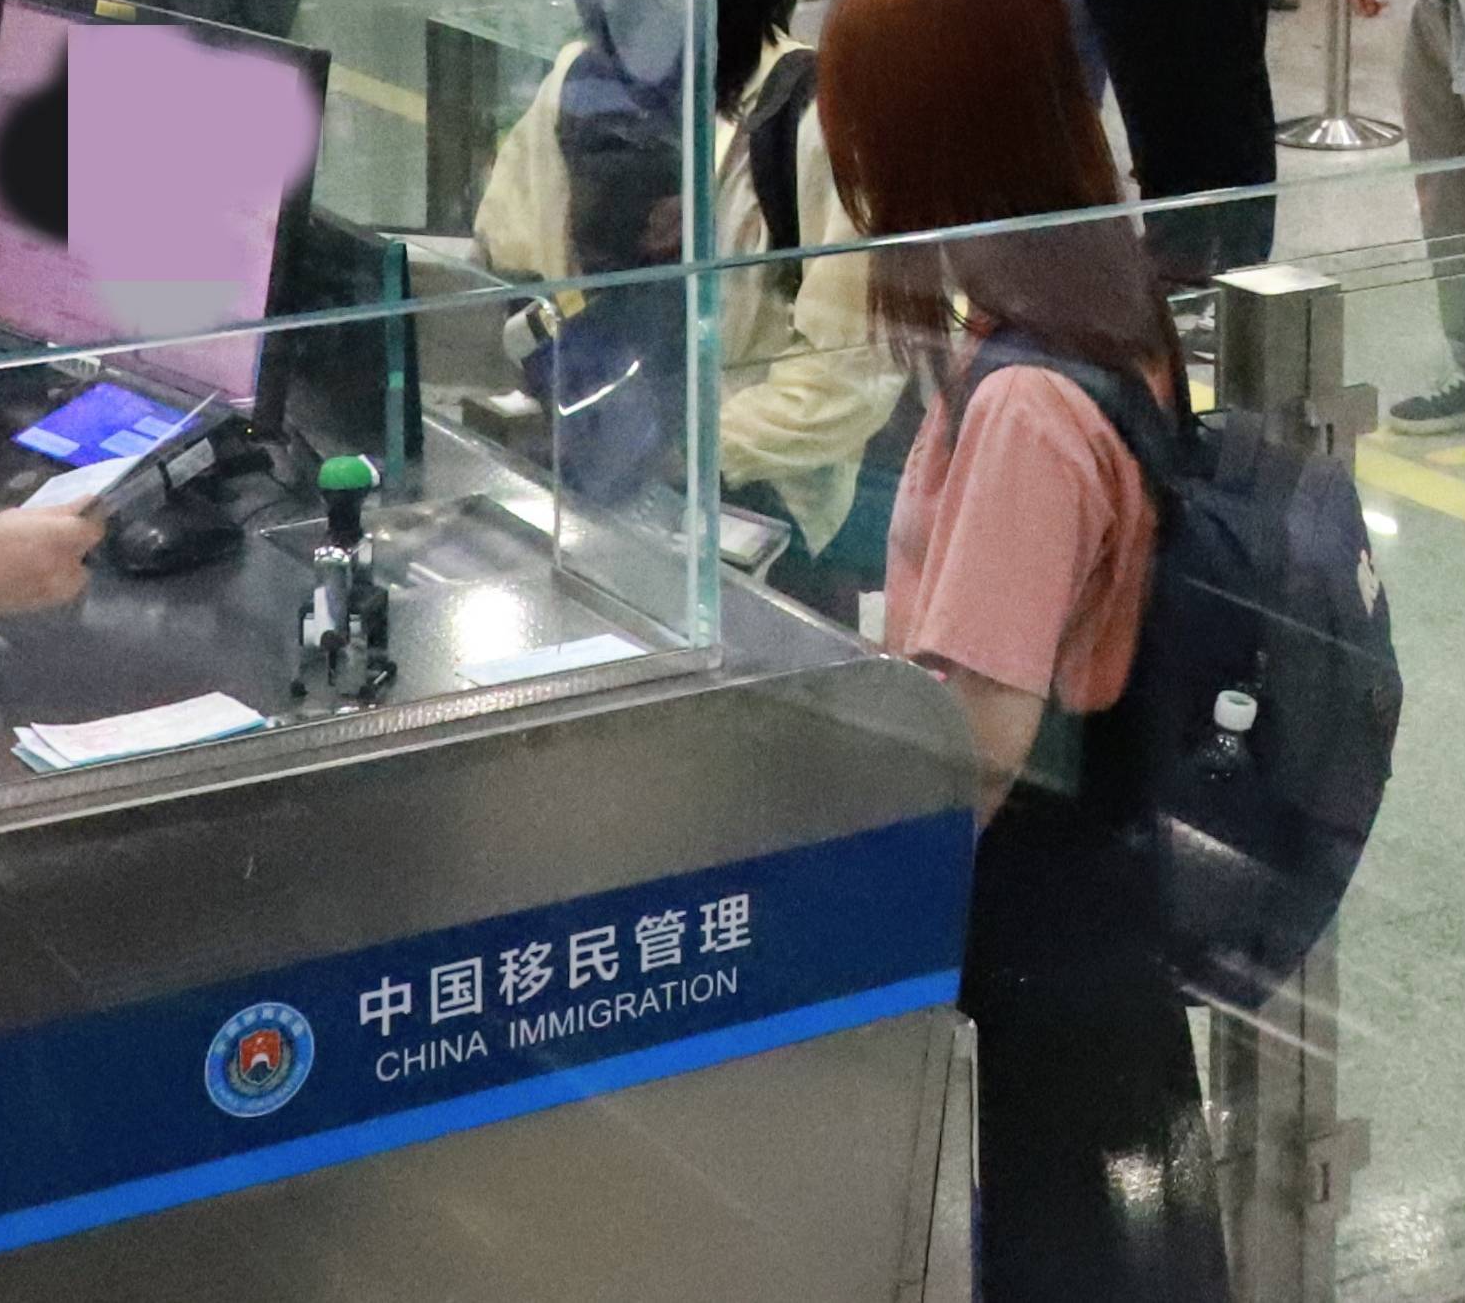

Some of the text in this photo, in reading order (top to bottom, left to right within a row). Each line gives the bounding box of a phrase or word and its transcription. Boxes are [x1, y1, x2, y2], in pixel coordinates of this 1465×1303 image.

[358, 893, 754, 1037] 中国移民管理
[375, 1029, 489, 1082] CHINA
[508, 965, 740, 1050] IMMIGRATION
